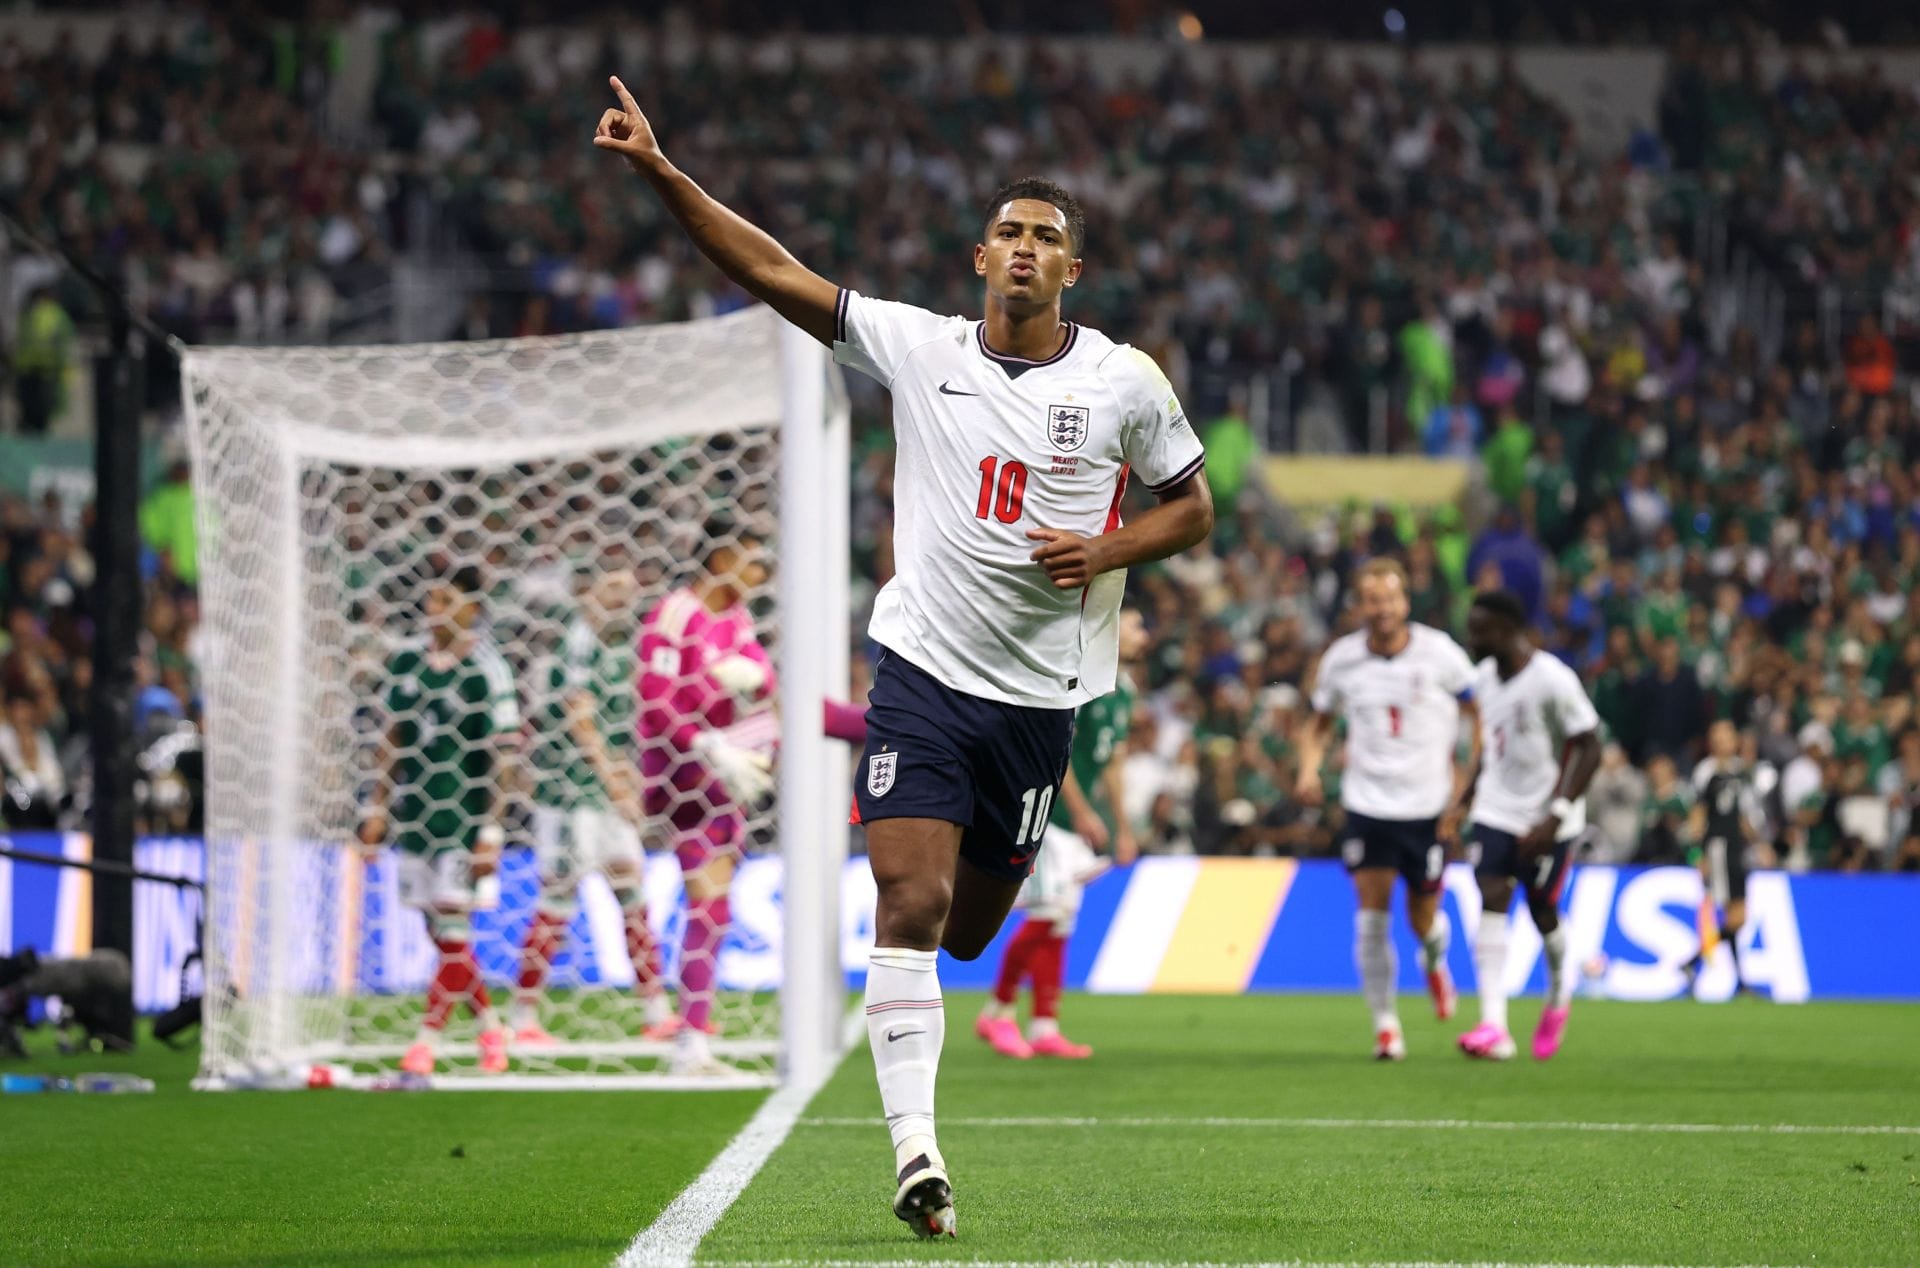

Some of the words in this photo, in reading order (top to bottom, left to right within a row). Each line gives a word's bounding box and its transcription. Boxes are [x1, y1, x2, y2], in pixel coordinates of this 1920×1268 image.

[1052, 455, 1079, 465] MEXICO
[975, 455, 1029, 525] 10
[1015, 783, 1054, 846] 10
[1535, 855, 1555, 892] 7
